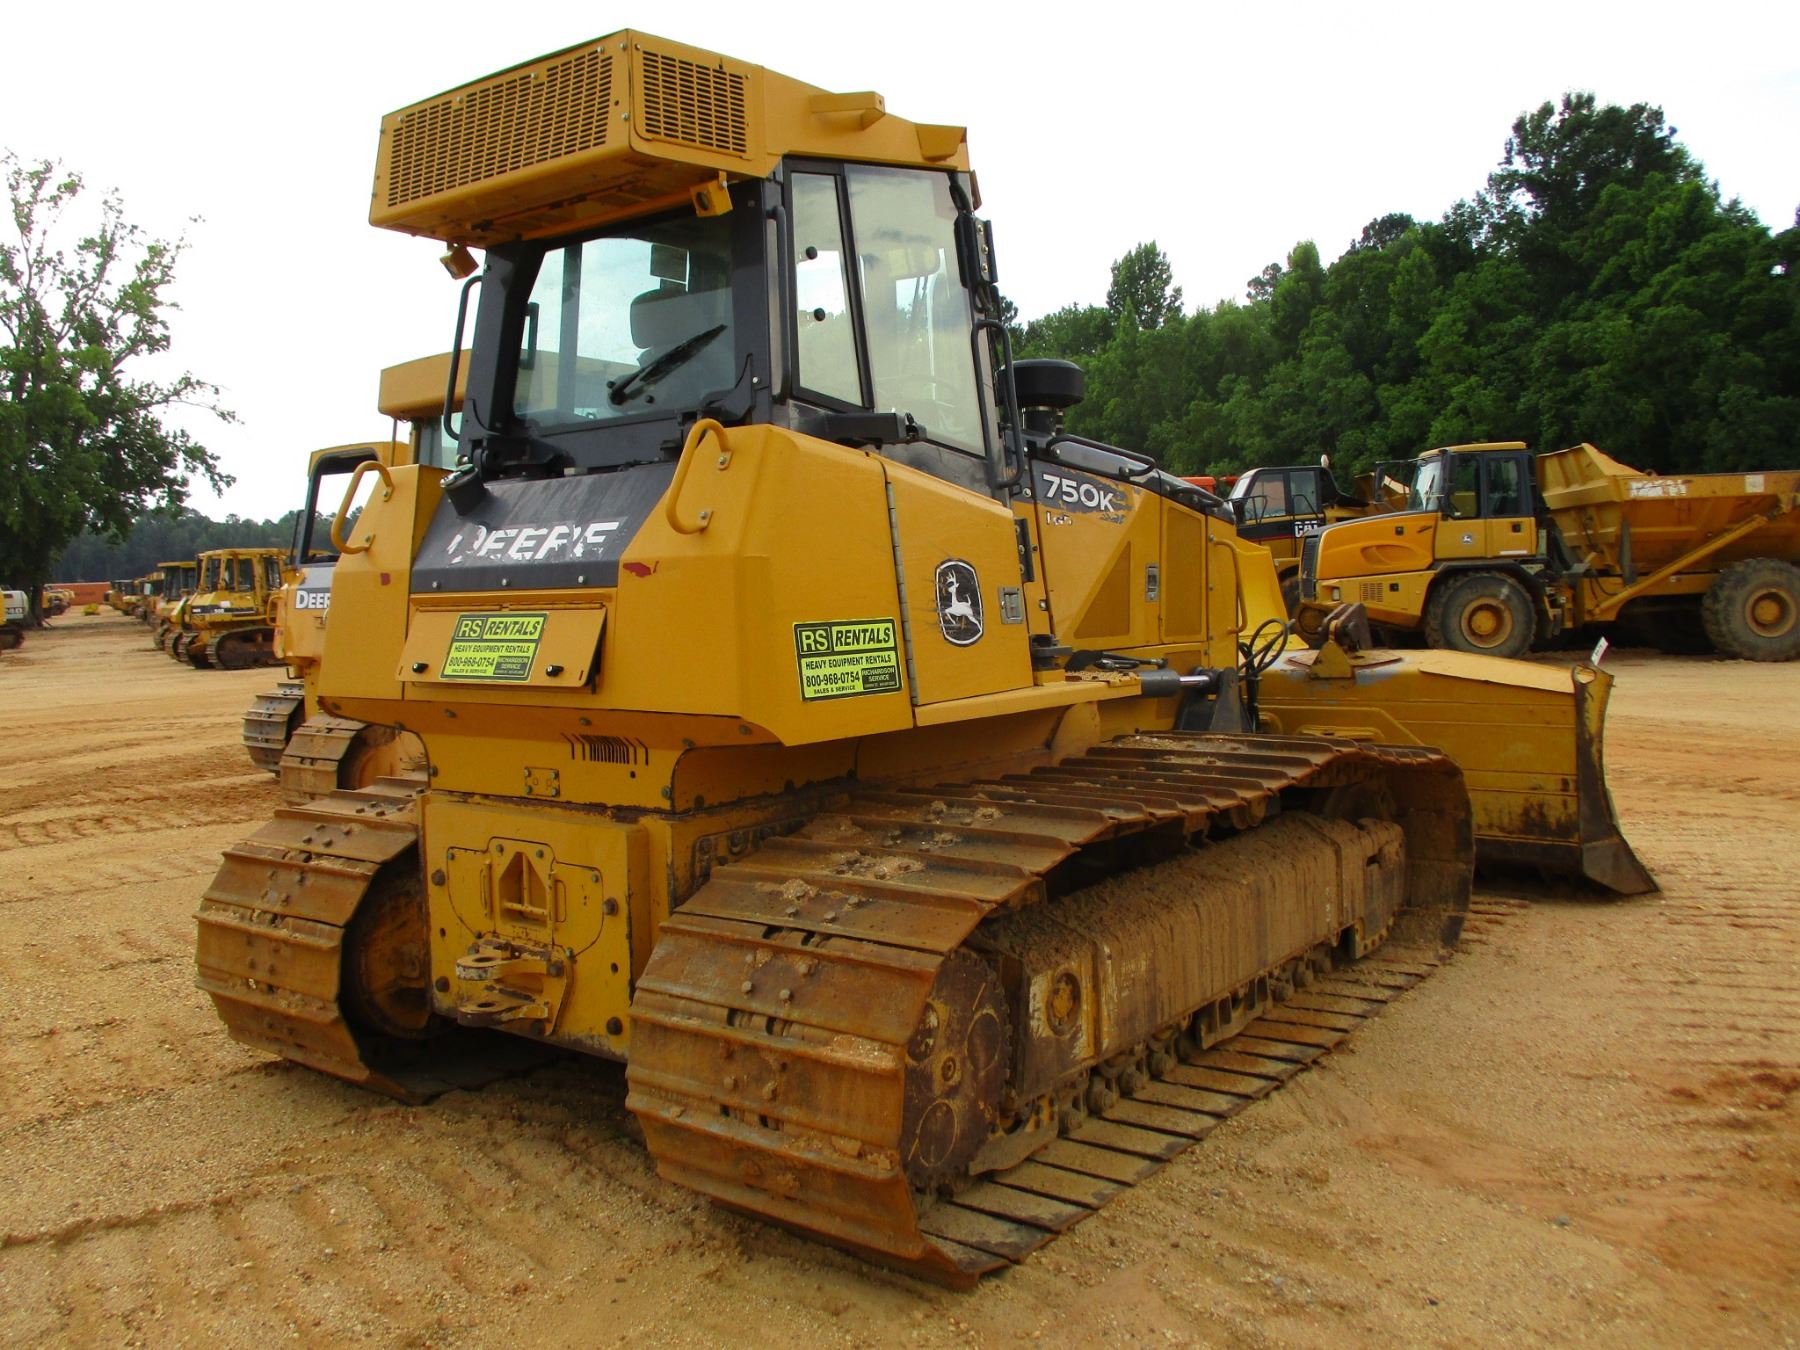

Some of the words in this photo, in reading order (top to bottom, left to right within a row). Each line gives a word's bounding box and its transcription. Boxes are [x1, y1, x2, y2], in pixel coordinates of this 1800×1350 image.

[1042, 473, 1114, 512] 750K
[295, 590, 331, 609] DEER
[458, 619, 482, 637] RS
[485, 620, 540, 636] RENTALS
[801, 629, 828, 651] RS
[834, 627, 891, 647] RENTALS
[454, 644, 473, 653] HEAVY
[472, 645, 504, 653] EQUIPMENT
[505, 645, 531, 654] RENTALS
[805, 659, 827, 671] HEAVY
[828, 656, 864, 669] EQUIPMENT
[865, 654, 892, 665] RENTALS
[805, 671, 860, 688] 800-968-0754
[862, 667, 895, 676] RICHARDSON
[868, 674, 890, 682] SERVICE
[813, 687, 830, 695] SALES
[835, 684, 856, 693] SERVICE
